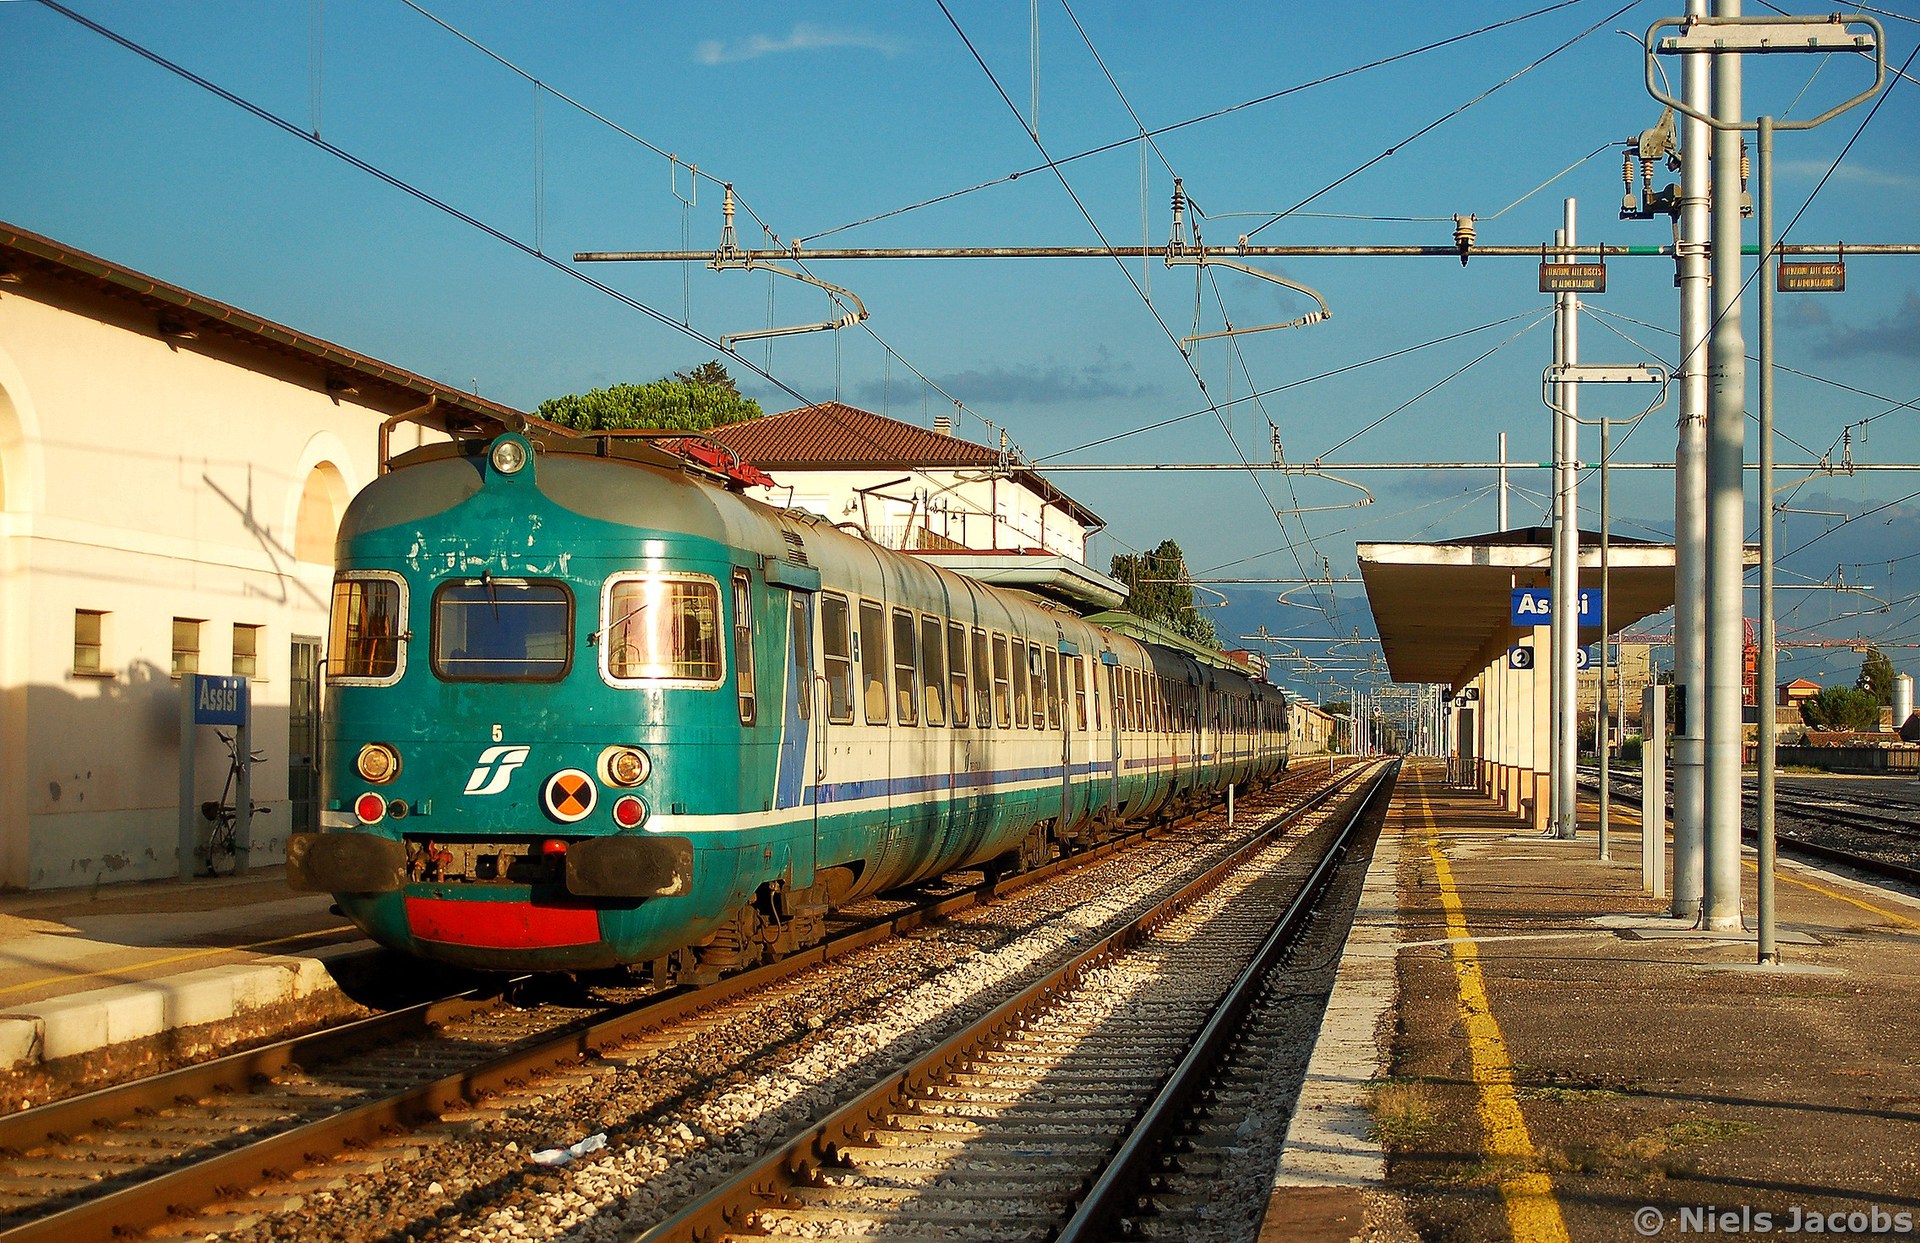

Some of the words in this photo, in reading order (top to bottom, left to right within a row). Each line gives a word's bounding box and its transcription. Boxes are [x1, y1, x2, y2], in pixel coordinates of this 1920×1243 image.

[1517, 593, 1588, 614] Asi
[1516, 652, 1526, 664] 2
[199, 679, 238, 712] Assisi
[492, 725, 503, 742] 5
